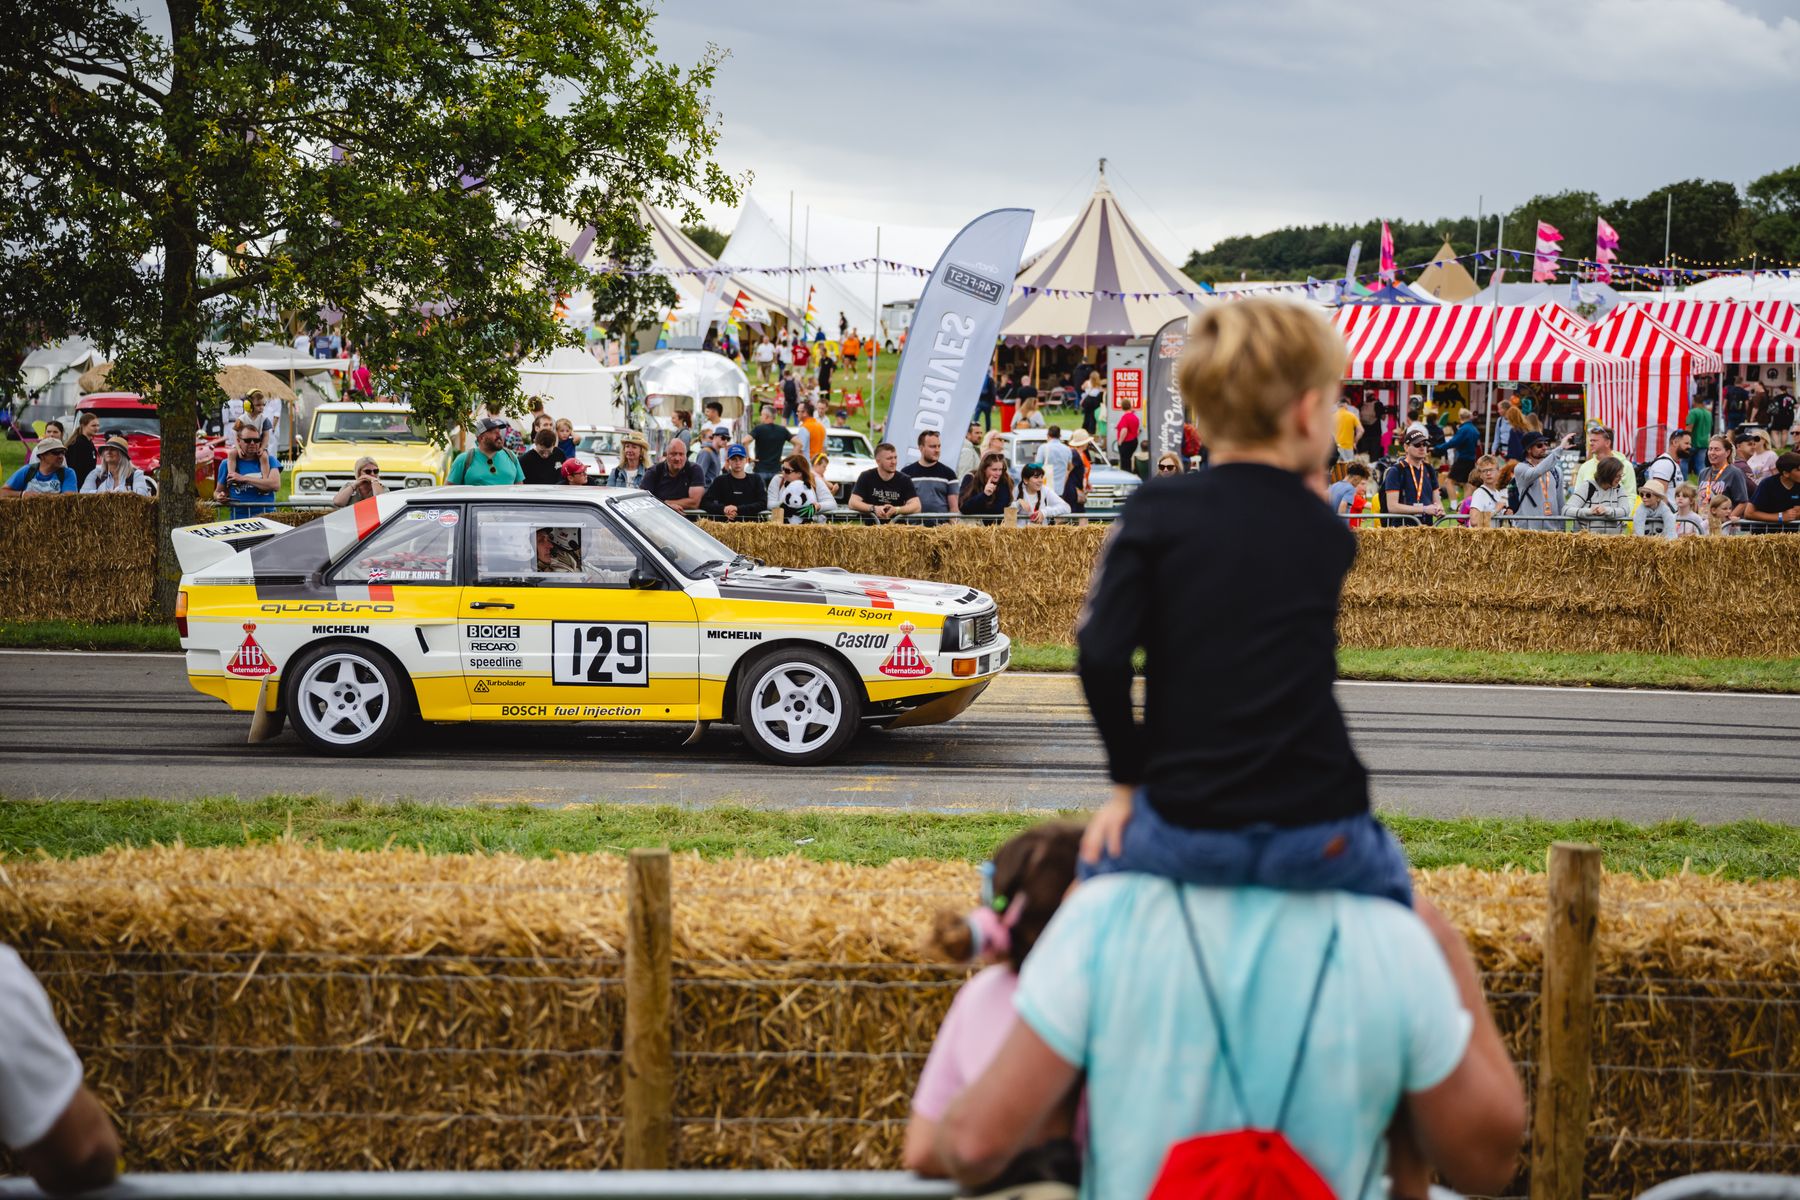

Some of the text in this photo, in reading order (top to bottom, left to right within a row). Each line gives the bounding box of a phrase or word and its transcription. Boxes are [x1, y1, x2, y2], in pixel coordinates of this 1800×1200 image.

[390, 571, 440, 579] ANDY KRINKS
[261, 602, 394, 614] quattro
[827, 607, 893, 621] Audi Sport
[312, 625, 369, 634] MICHELIN
[469, 626, 518, 638] BOGE
[707, 630, 762, 640] MICHELIN
[835, 632, 889, 649] Castrol
[471, 643, 516, 651] RECARO
[238, 645, 263, 666] HB
[572, 626, 643, 682] 129
[893, 646, 919, 667] HB
[470, 657, 522, 669] speedline
[232, 666, 271, 674] international
[885, 667, 926, 675] international
[502, 705, 641, 718] BOSCH fuel injection
